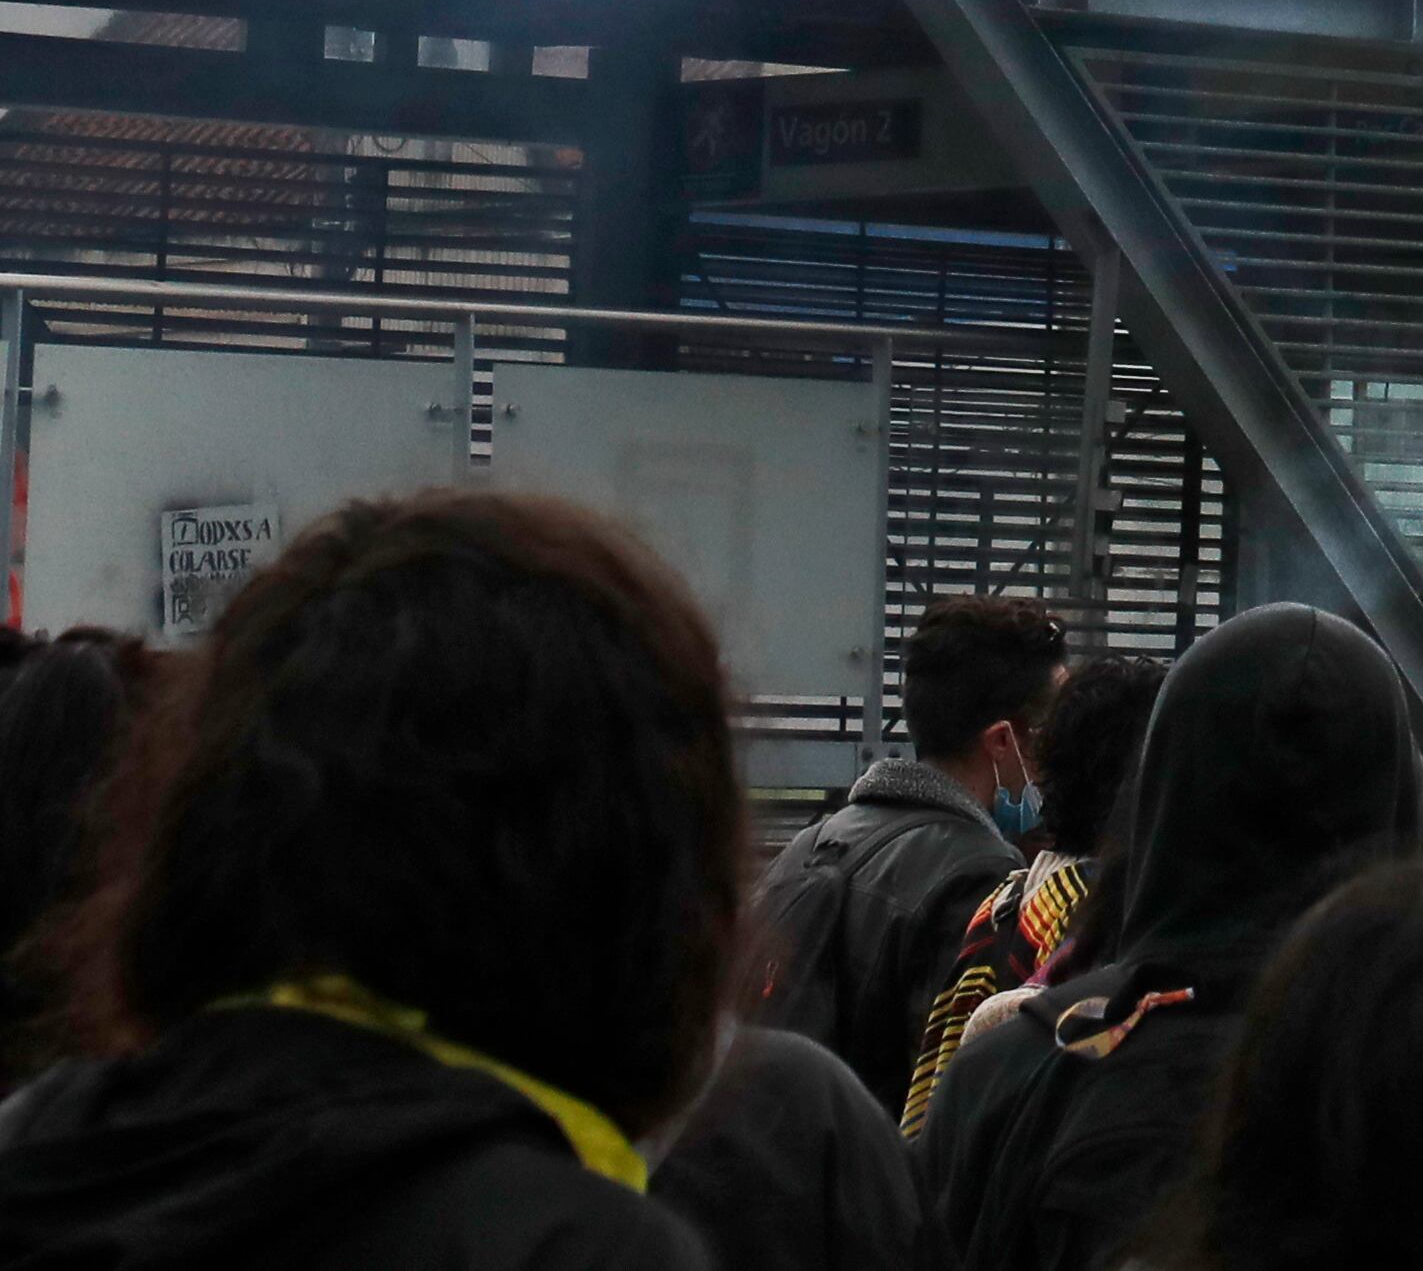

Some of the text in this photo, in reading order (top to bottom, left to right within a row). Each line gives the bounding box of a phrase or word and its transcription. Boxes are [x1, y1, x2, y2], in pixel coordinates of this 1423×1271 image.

[877, 110, 892, 143] 2
[256, 517, 272, 541] A
[169, 549, 252, 574] COLARSE
